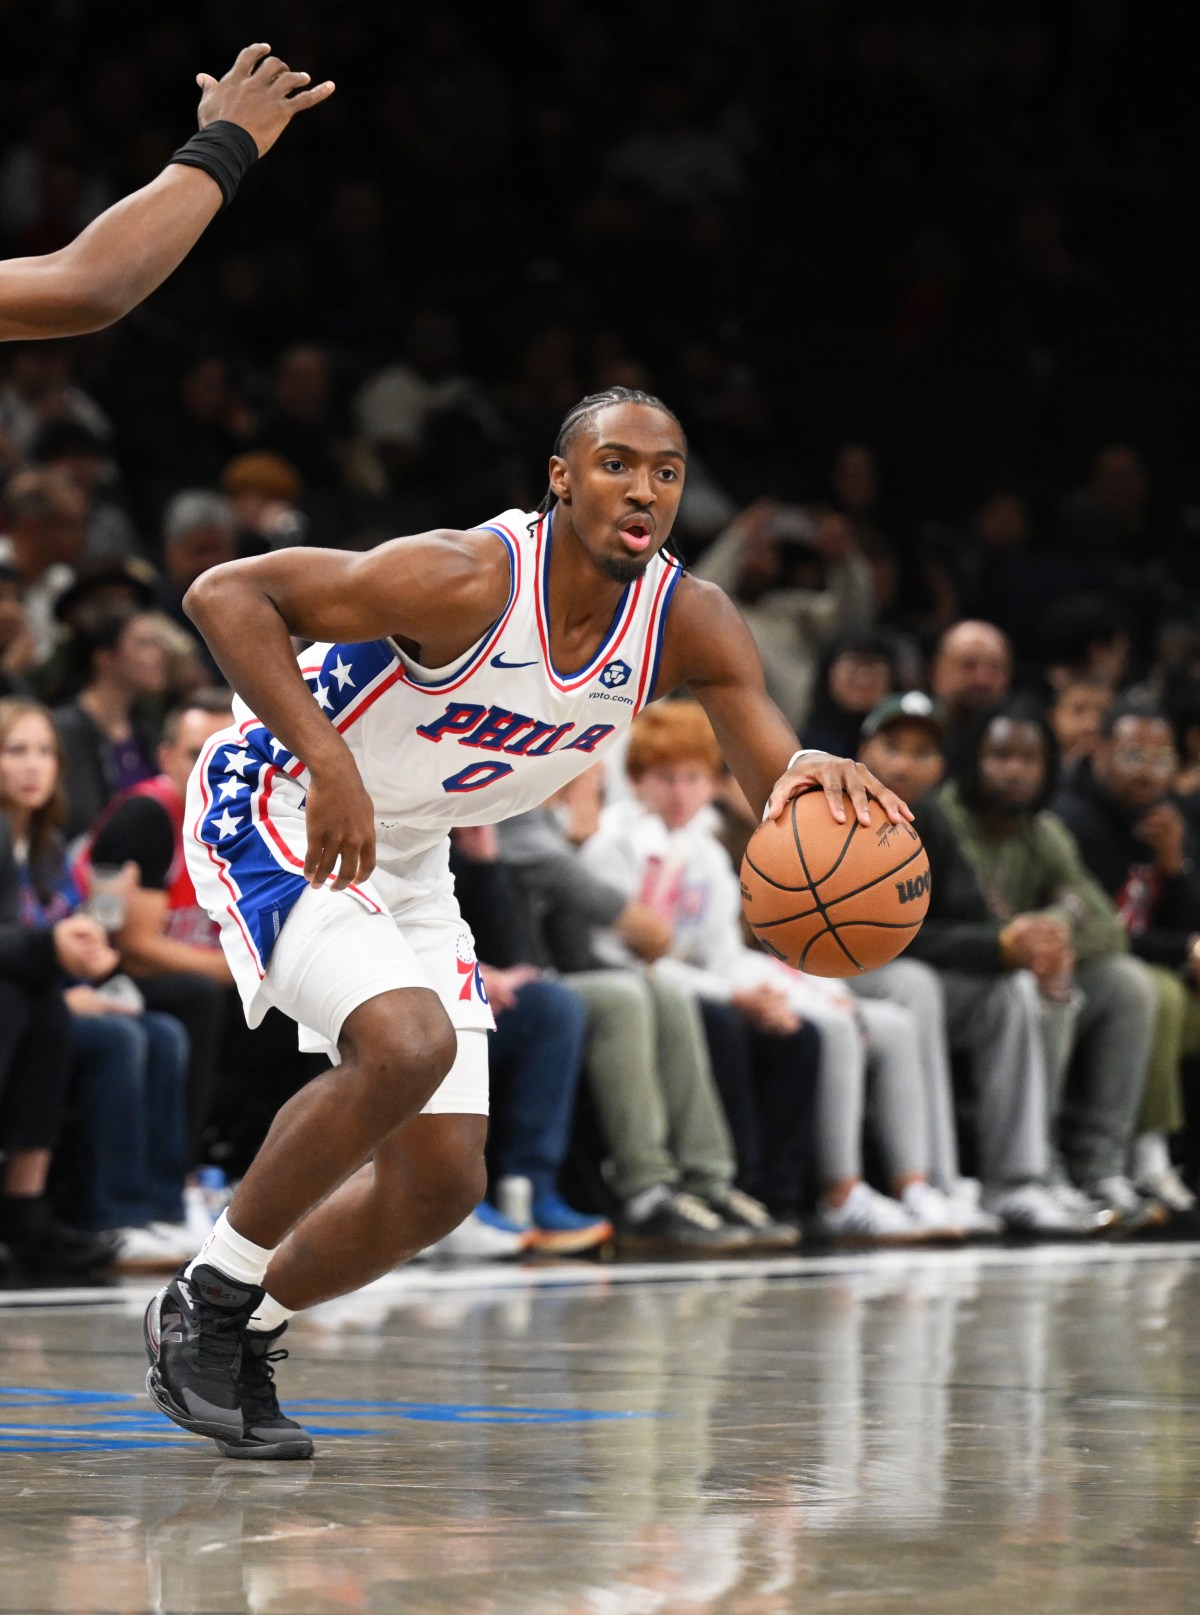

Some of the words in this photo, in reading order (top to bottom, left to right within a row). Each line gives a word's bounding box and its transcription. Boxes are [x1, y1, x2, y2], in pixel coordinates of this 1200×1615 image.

[588, 691, 634, 706] ypto.com
[416, 702, 615, 756] PHILA
[442, 760, 514, 792] 0
